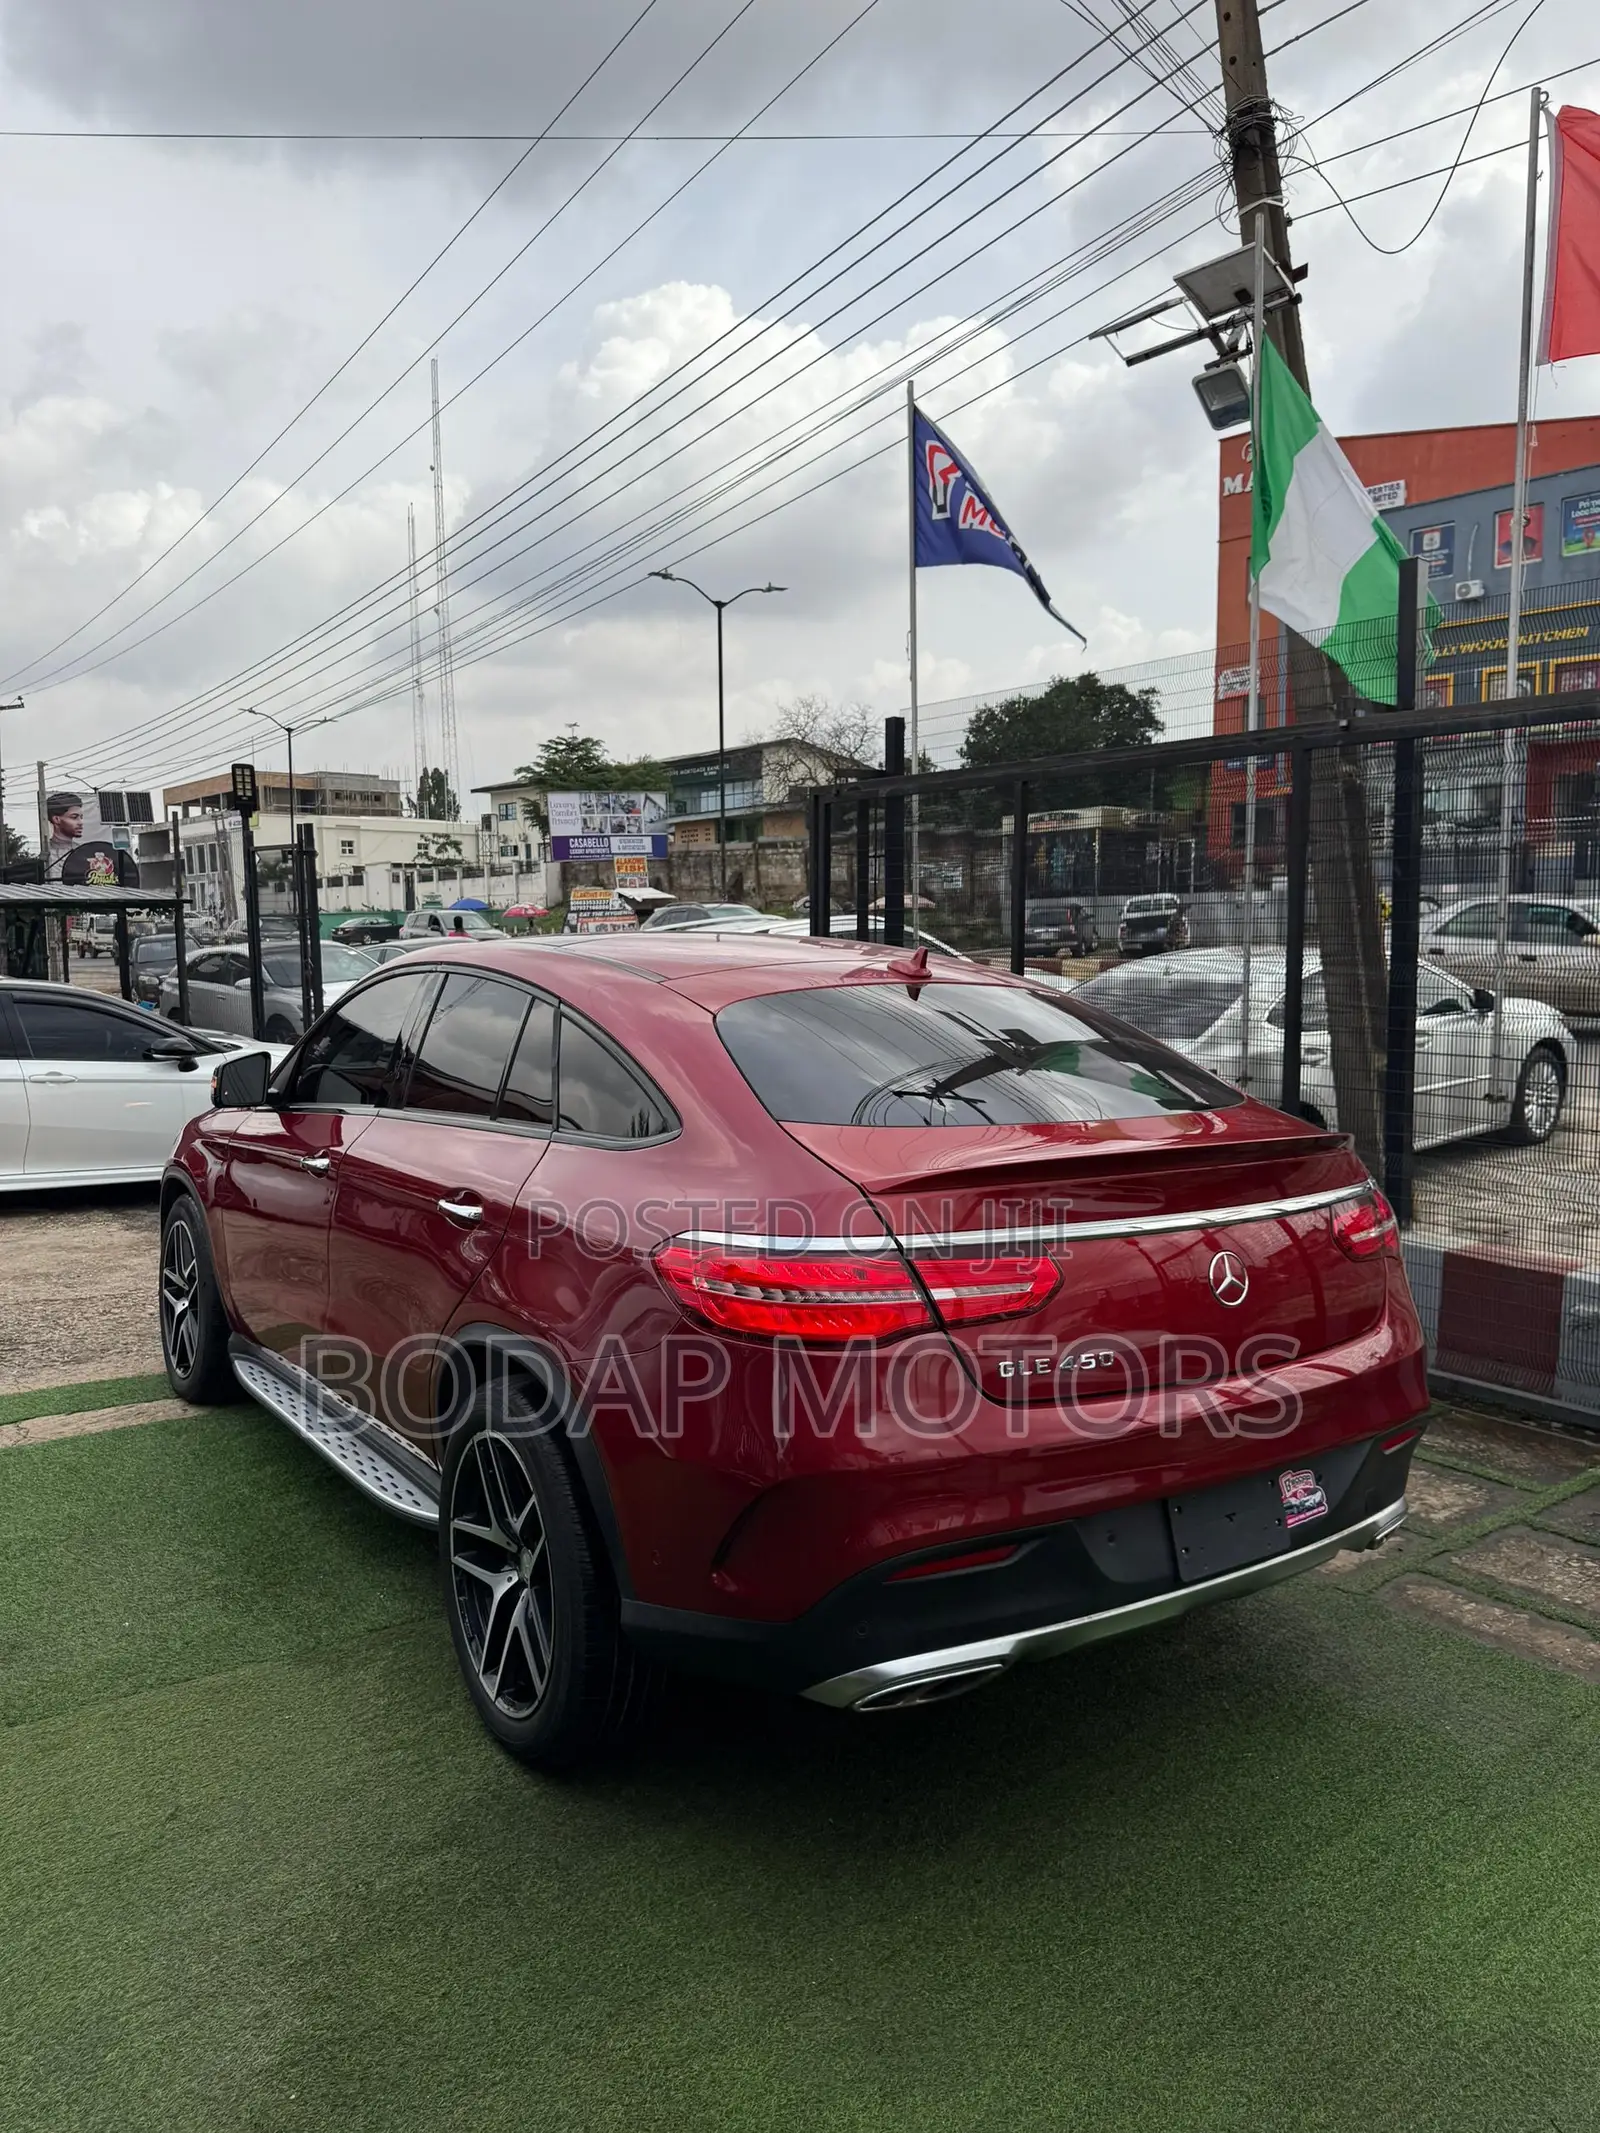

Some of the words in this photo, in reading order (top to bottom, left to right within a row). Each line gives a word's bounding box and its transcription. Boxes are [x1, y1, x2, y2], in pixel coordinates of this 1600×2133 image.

[569, 837, 609, 849] CASABELLO
[617, 864, 646, 873] FISH
[999, 1358, 1052, 1378] GLE
[1059, 1351, 1114, 1371] 450
